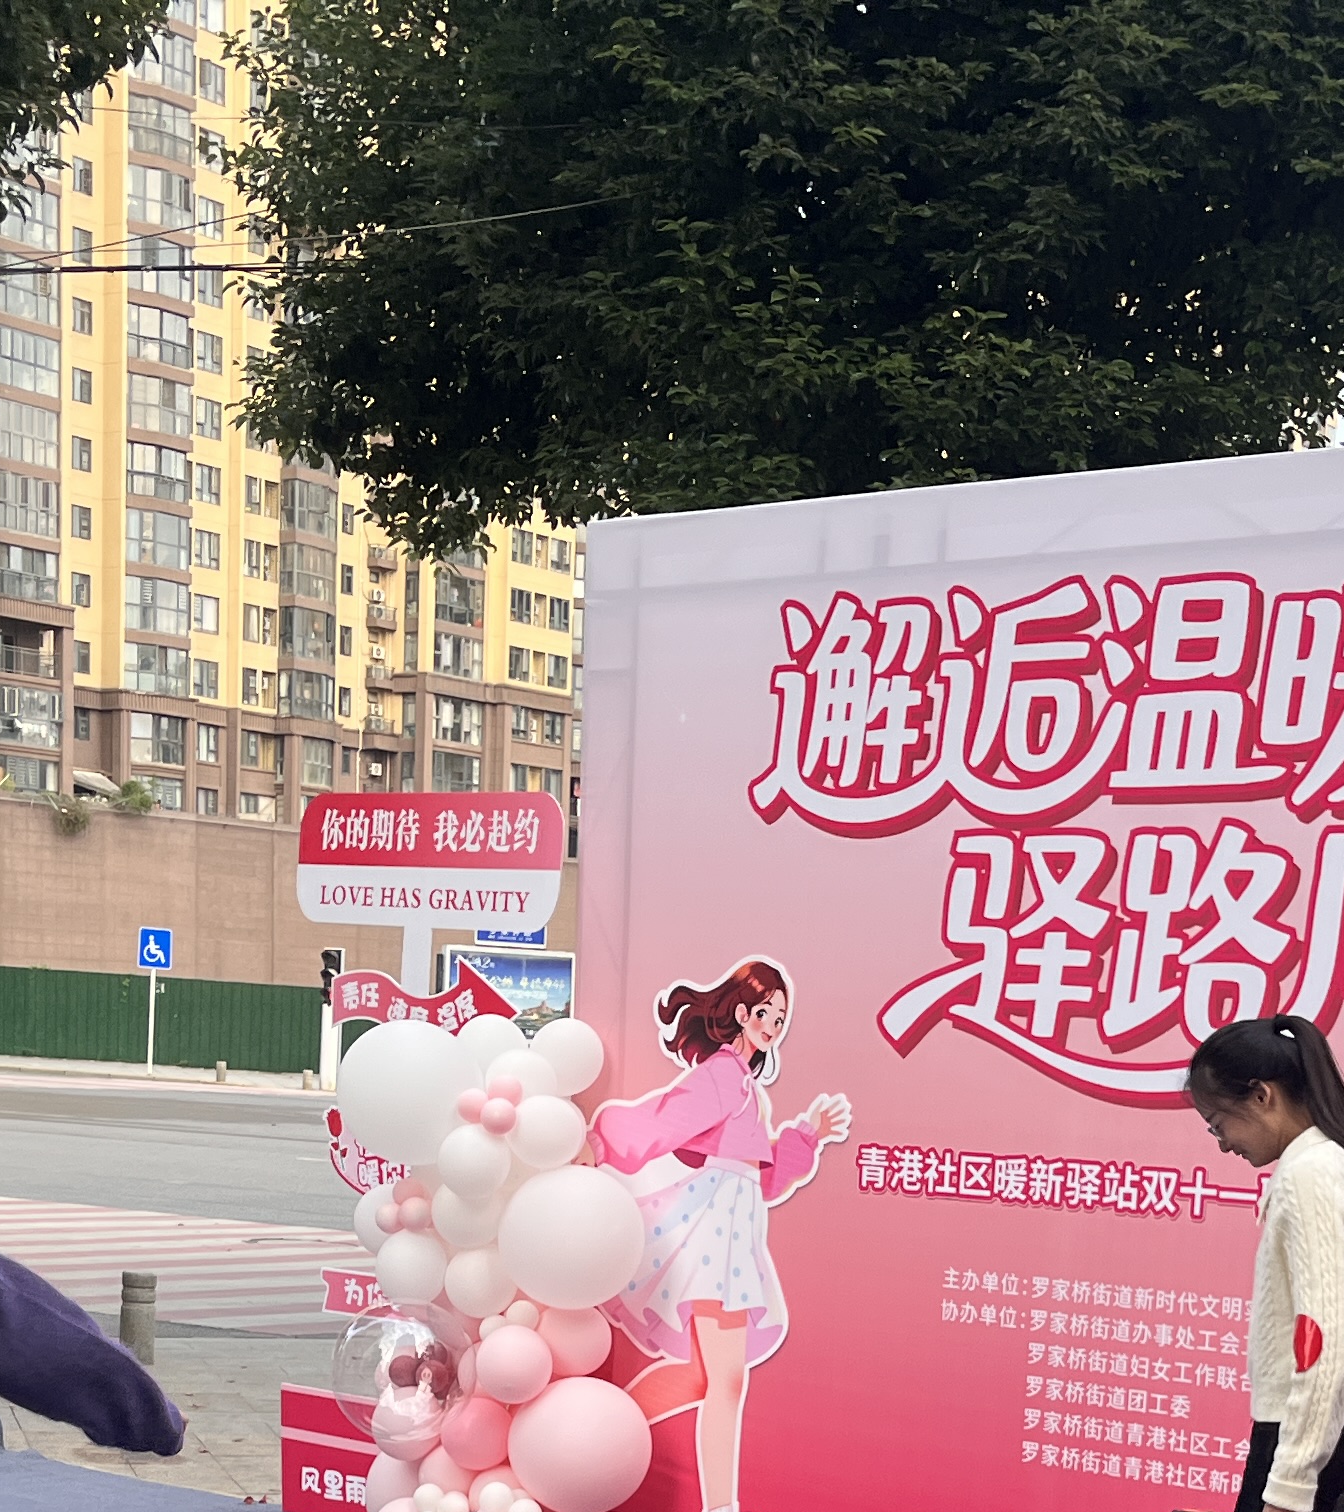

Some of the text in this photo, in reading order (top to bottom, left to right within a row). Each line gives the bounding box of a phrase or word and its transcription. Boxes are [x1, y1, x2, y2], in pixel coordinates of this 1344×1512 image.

[320, 808, 541, 854] 你的期待 我必赴约
[320, 885, 531, 914] LOVE HAS GRAVITY
[1025, 1374, 1192, 1421] 罗家桥街道团工委
[1023, 1407, 1251, 1462] 罗家桥街道青港社区工会
